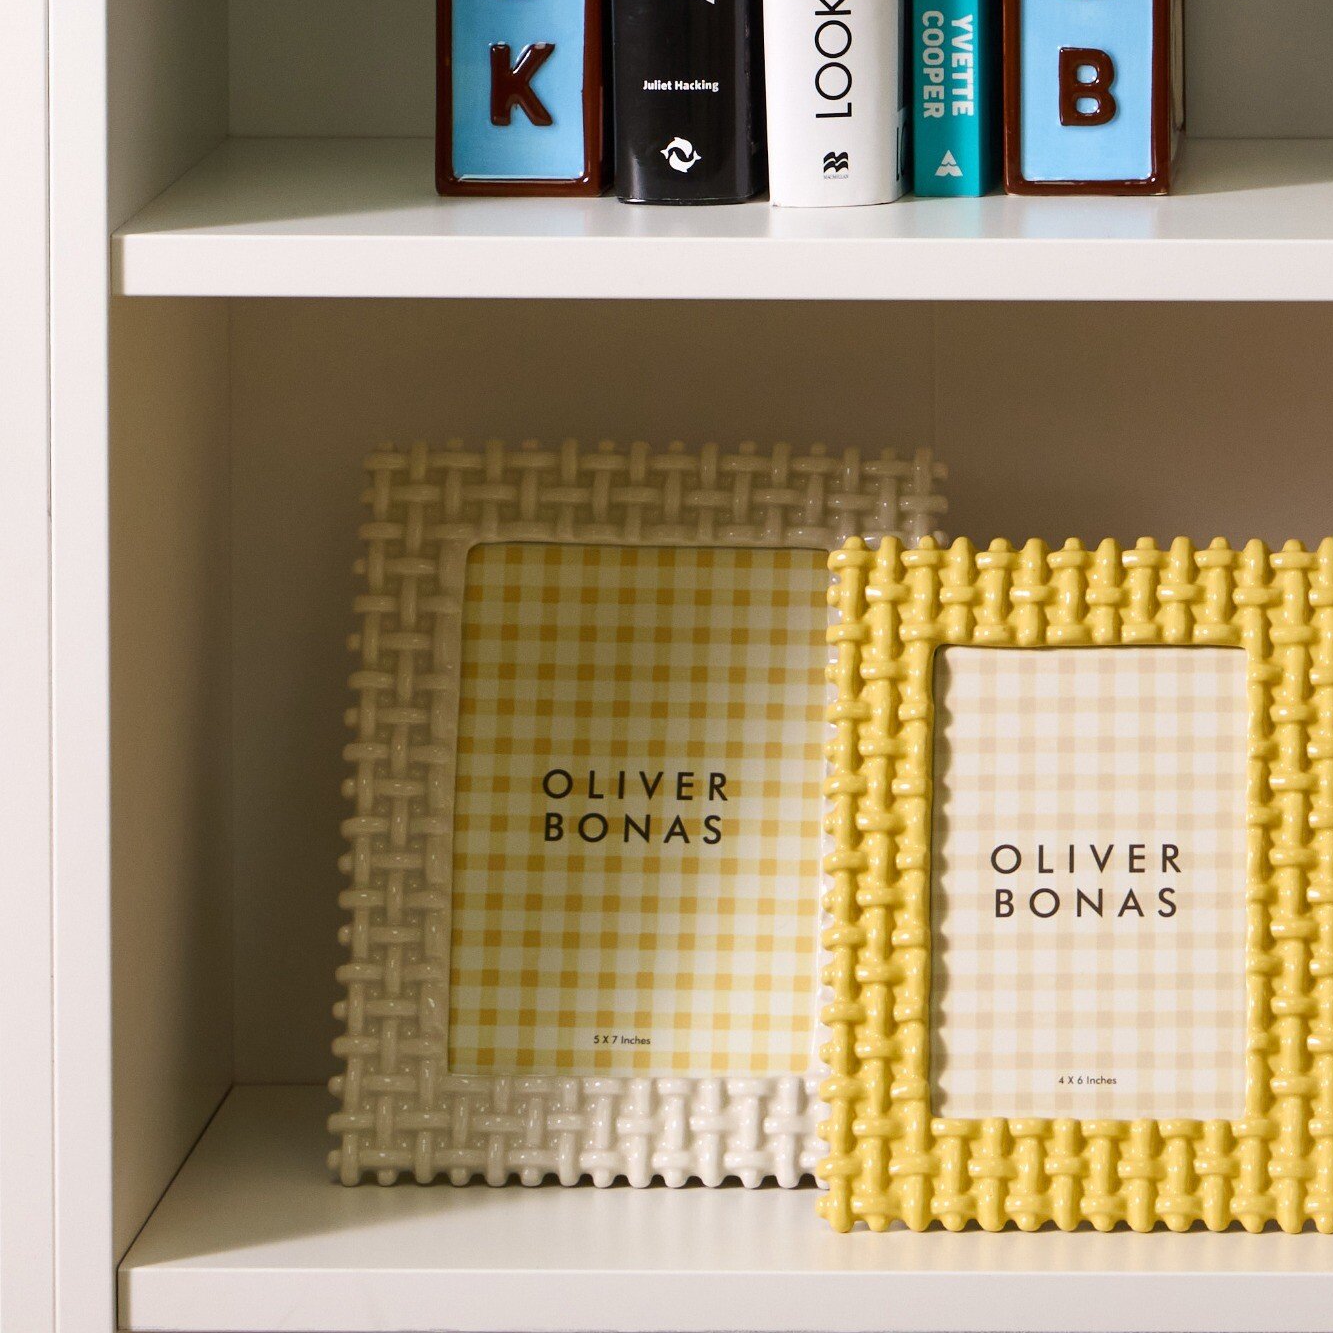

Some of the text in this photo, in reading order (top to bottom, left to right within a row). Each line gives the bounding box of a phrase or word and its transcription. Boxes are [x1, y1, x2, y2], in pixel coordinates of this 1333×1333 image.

[922, 10, 945, 118] COOPER
[951, 14, 975, 116] YVETTE
[643, 80, 719, 93] Juliet Hacking
[542, 769, 728, 801] OLIVER
[544, 812, 722, 844] BONAS
[990, 844, 1182, 875] OLIVER
[995, 887, 1177, 918] BONAS
[621, 1036, 651, 1045] Inches
[1086, 1076, 1117, 1085] Inches
